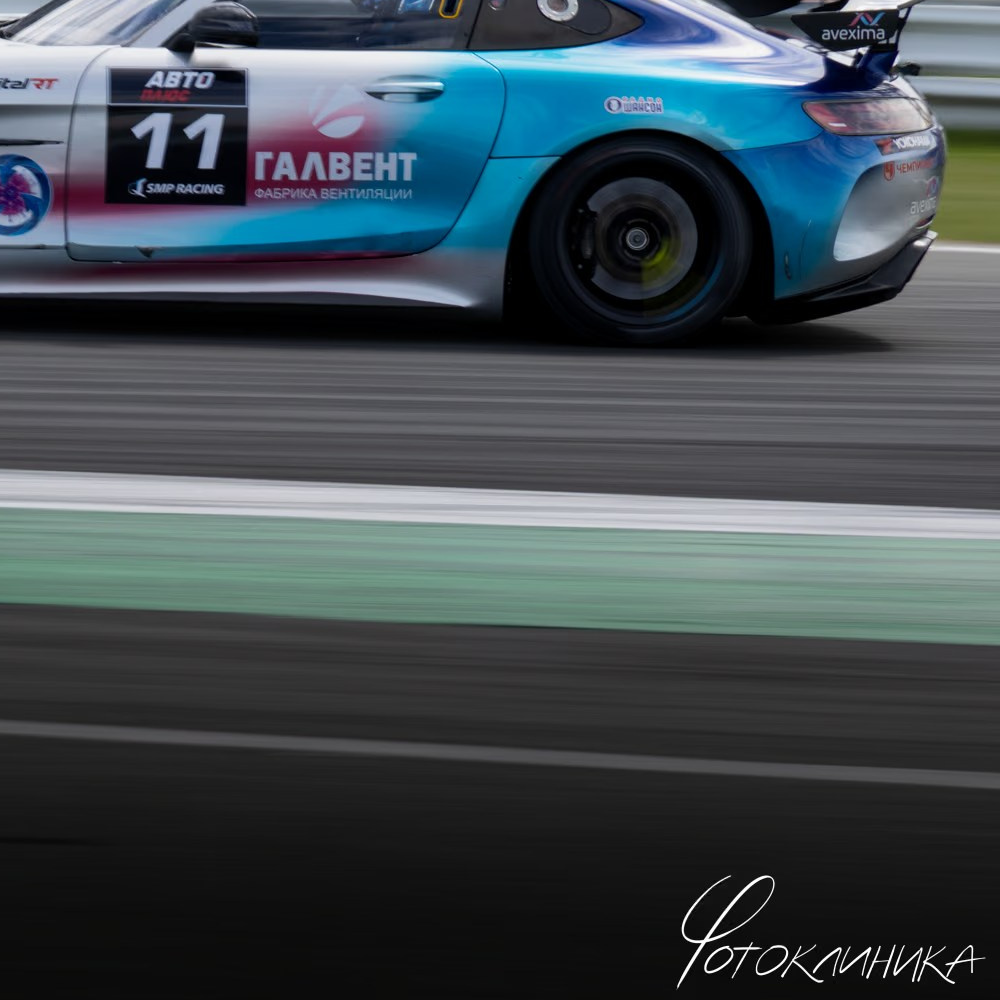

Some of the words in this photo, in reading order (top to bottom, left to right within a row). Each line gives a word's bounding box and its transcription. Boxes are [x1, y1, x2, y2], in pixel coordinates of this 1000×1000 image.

[821, 25, 885, 41] avexima
[144, 70, 215, 89] АВТО
[130, 112, 226, 170] 11
[254, 151, 418, 181] ГАЛВЕНТ
[146, 183, 174, 194] SMP
[175, 183, 226, 195] RACING
[254, 188, 318, 200] ФАБРИКА
[320, 188, 413, 201] ВЕНТИЛЯЦИИ
